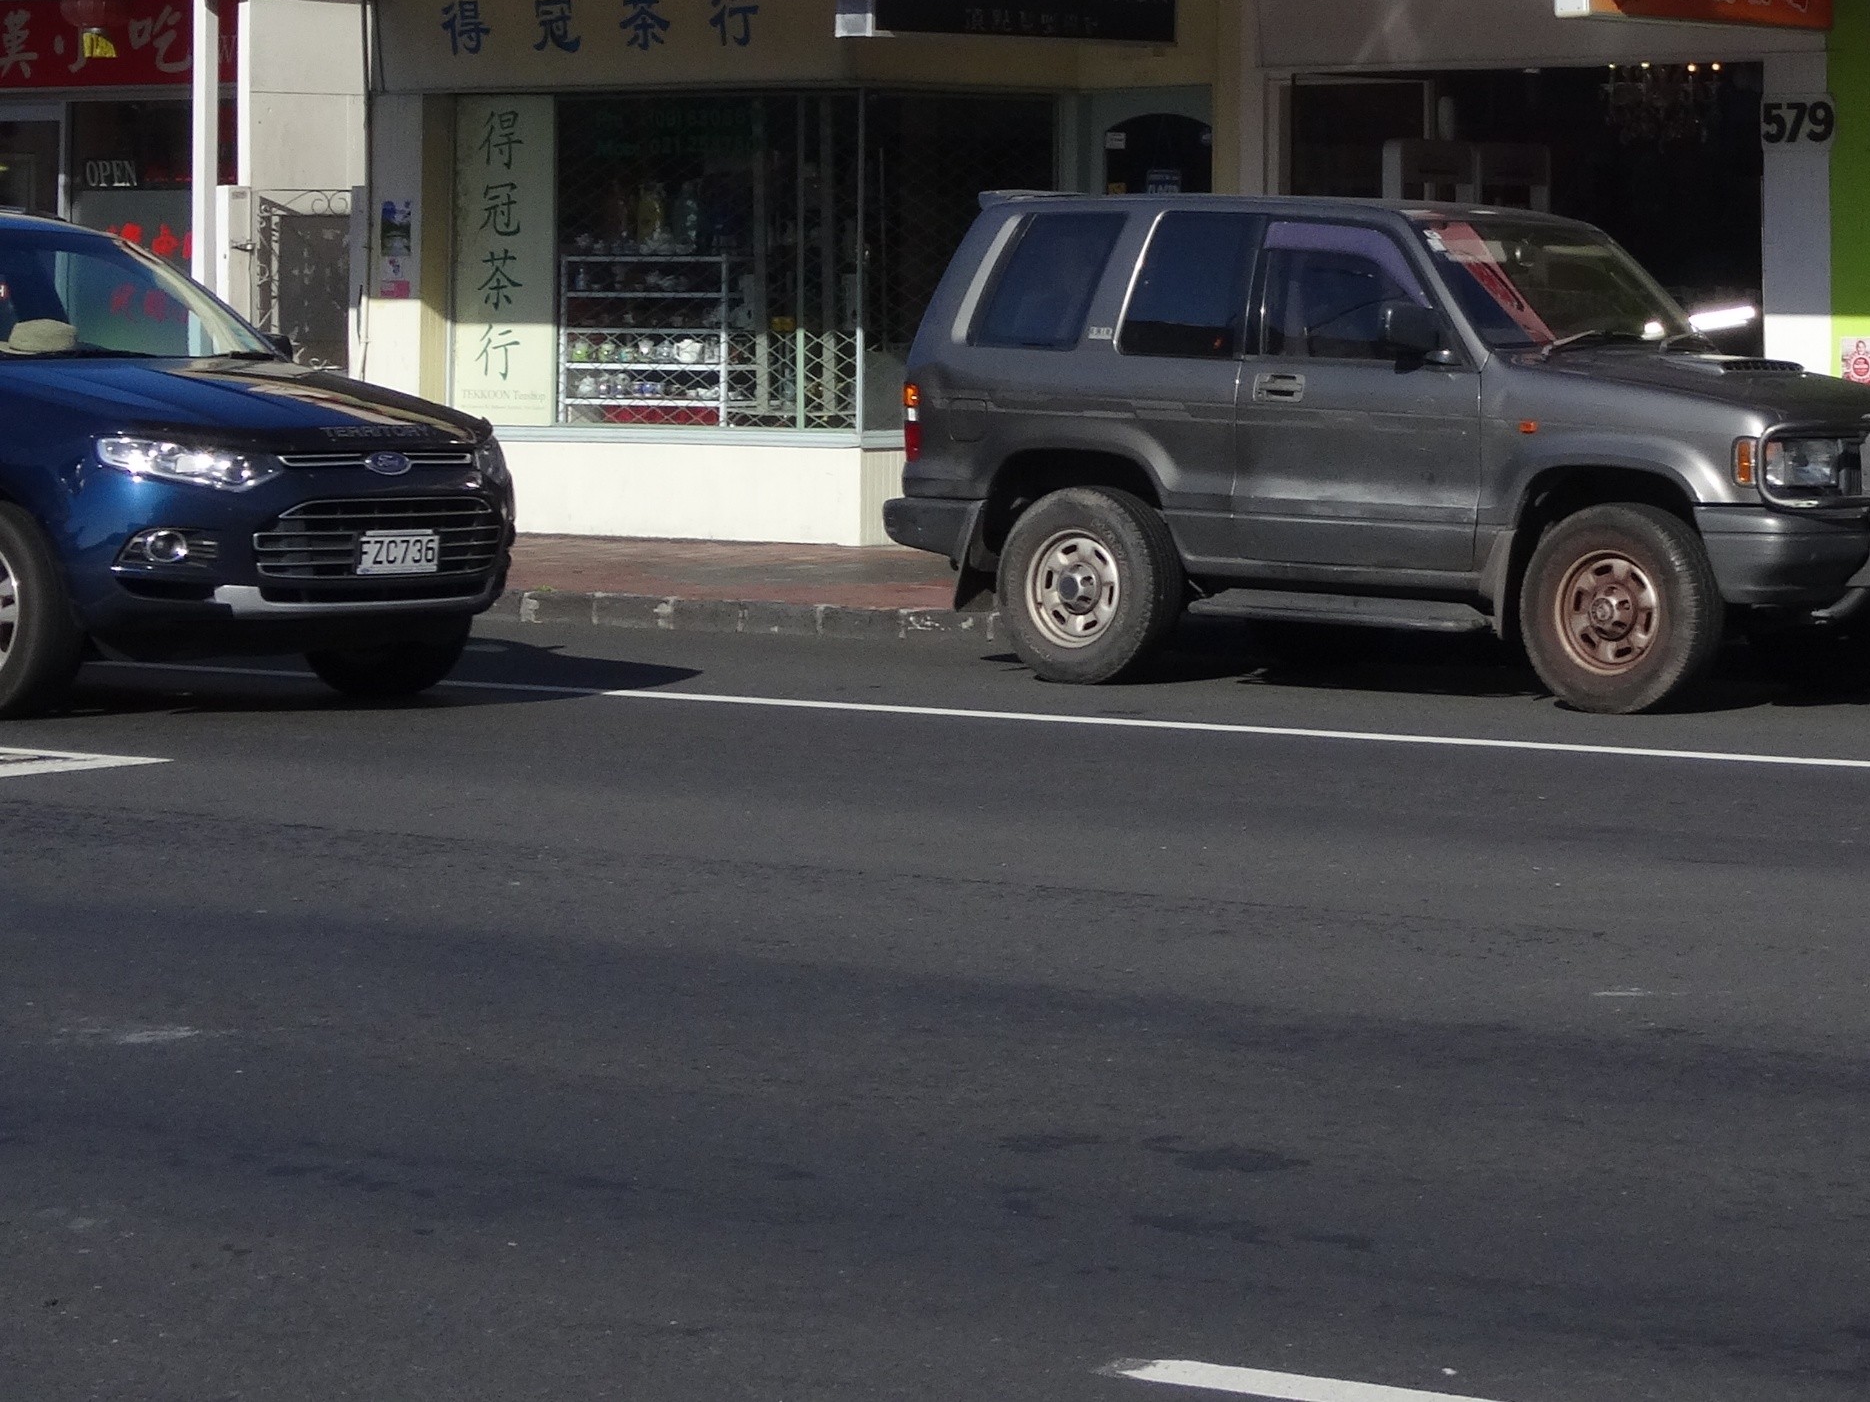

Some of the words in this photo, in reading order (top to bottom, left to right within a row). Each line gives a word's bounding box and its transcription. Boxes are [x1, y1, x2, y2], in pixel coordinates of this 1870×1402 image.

[1763, 101, 1834, 143] 579
[85, 160, 138, 187] OPEN
[473, 110, 524, 382] 得冠茶行
[359, 539, 436, 565] FZC736
